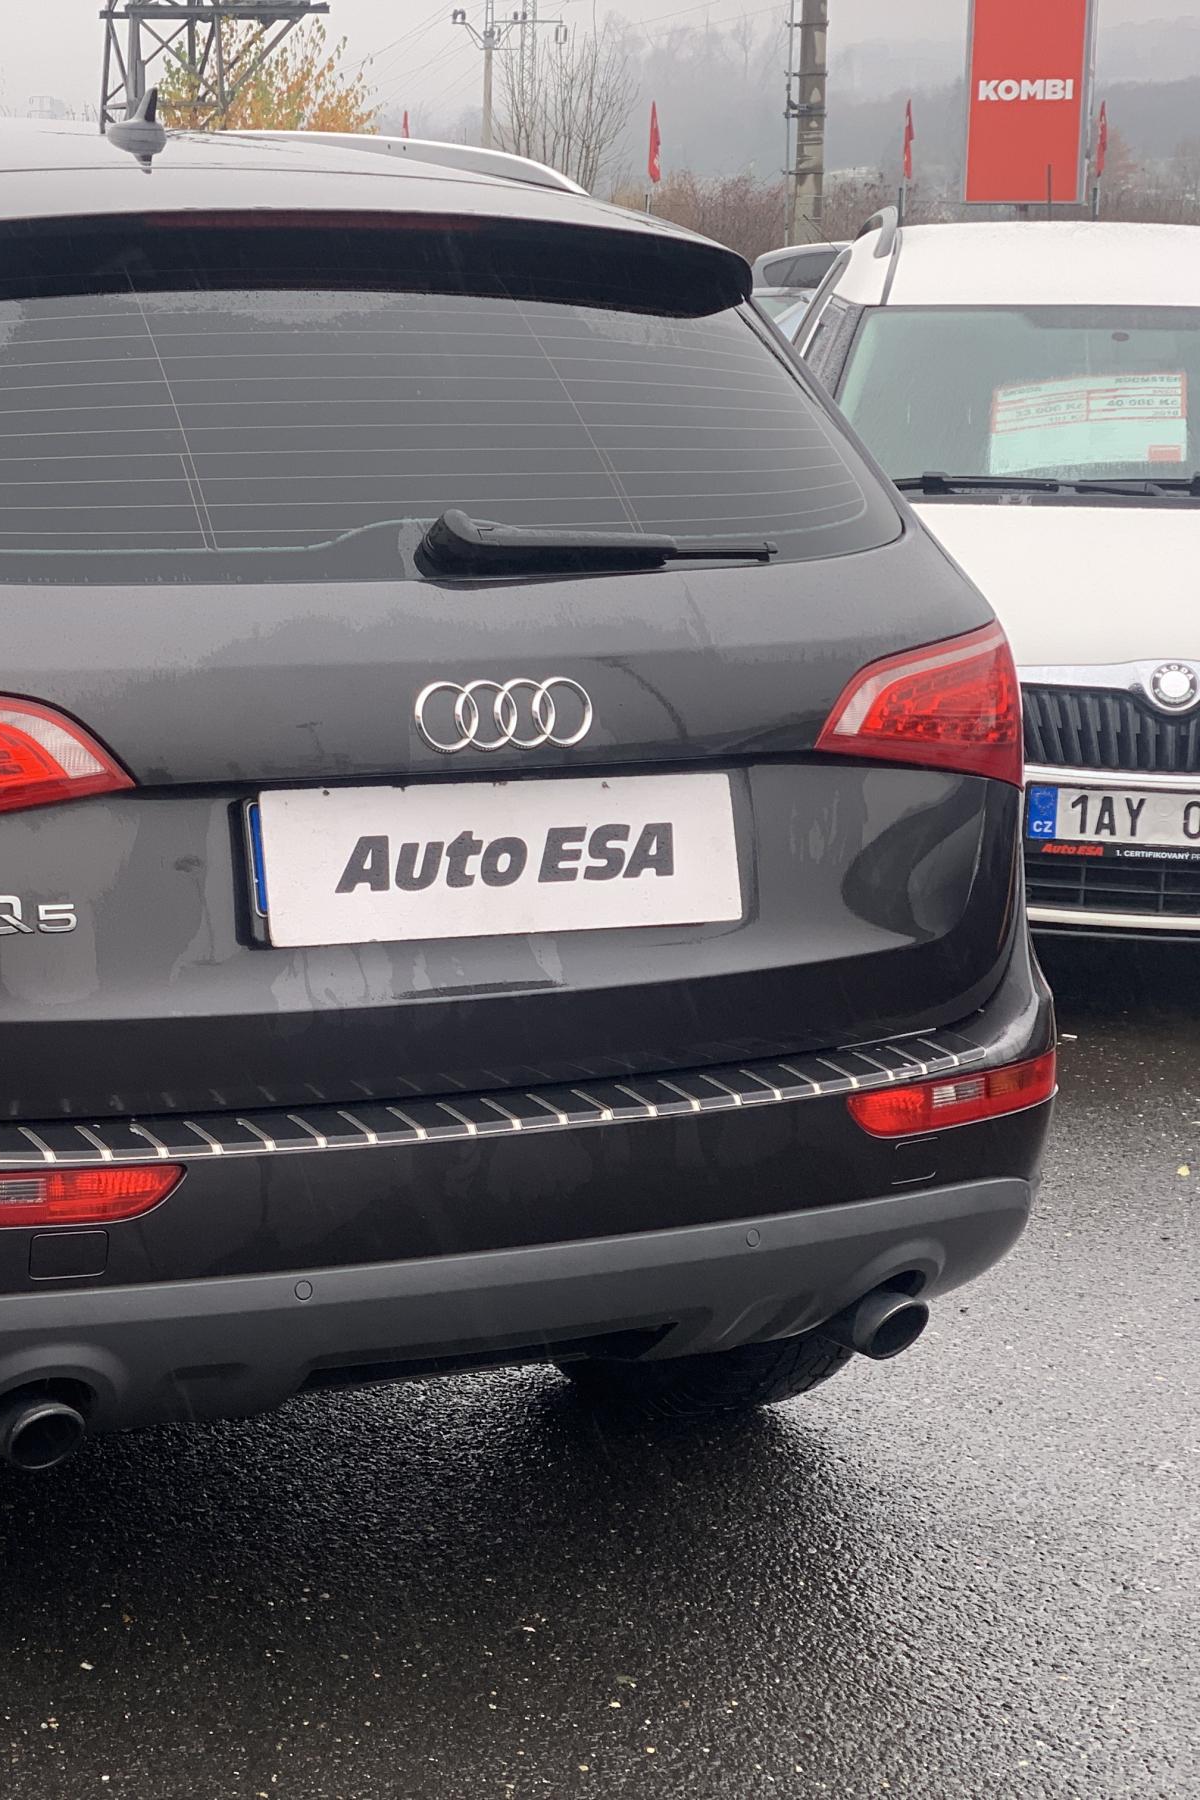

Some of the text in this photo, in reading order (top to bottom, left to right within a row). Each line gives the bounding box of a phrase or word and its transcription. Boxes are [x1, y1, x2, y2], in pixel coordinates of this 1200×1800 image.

[978, 79, 1073, 101] KOMBI
[1071, 794, 1146, 837] 1AY
[1033, 821, 1052, 833] CZ
[335, 822, 674, 894] Auto ESA
[1041, 844, 1104, 856] Auto ESA
[1124, 850, 1190, 859] CERTIFIKOVANÝ
